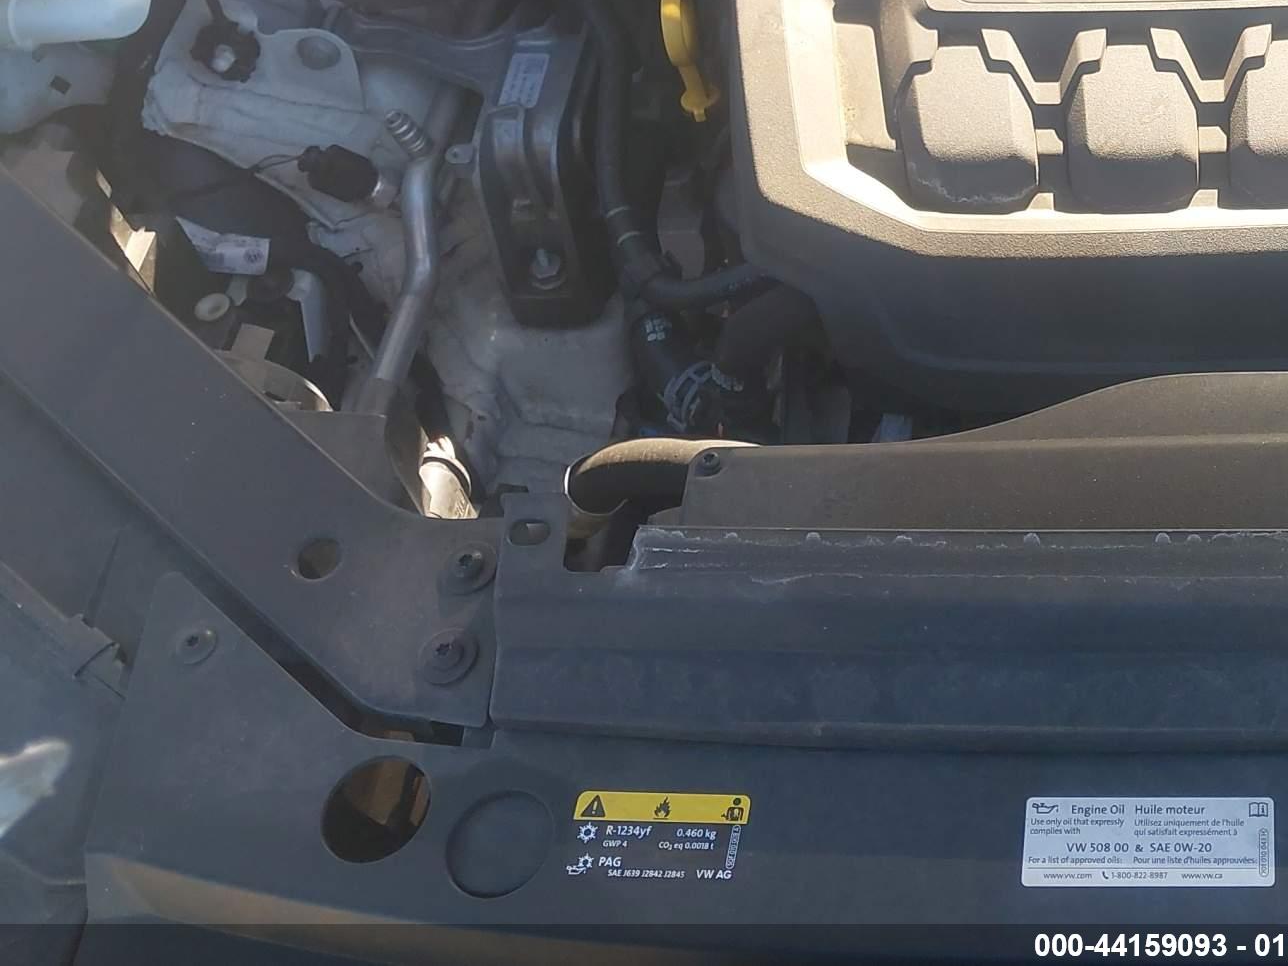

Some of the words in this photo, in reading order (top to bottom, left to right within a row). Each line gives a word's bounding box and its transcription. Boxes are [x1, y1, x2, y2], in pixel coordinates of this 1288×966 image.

[1071, 804, 1107, 817] Engine
[1110, 804, 1125, 814] Oil
[1135, 804, 1163, 815] Huile
[1165, 805, 1206, 815] moteur
[1030, 818, 1045, 826] Use
[1046, 818, 1062, 827] only
[1063, 818, 1072, 826] oil
[1073, 818, 1089, 826] that
[1090, 818, 1124, 828] expressly
[1134, 819, 1161, 827] Utilisez
[1163, 819, 1209, 829] uniquement
[1211, 819, 1220, 827] de
[1221, 818, 1245, 827] l'huile
[606, 825, 653, 839] R-1234yf
[676, 828, 704, 838] 0.460
[705, 829, 717, 840] kg
[1030, 827, 1062, 836] complies
[1064, 827, 1081, 835] with
[1133, 829, 1146, 838] qui
[1147, 828, 1177, 836] satisfait
[1178, 828, 1232, 838] expressément
[674, 842, 684, 851] eq
[684, 841, 709, 850] 0.0018
[1066, 842, 1087, 853] VW
[1090, 842, 1111, 853] 508
[1113, 842, 1130, 853] 00
[1134, 844, 1144, 853] &
[1150, 842, 1171, 852] SAE
[1173, 842, 1212, 852] 0W-20
[598, 856, 622, 867] PAG
[1028, 856, 1040, 864] For
[1048, 856, 1059, 864] list
[1060, 856, 1069, 864] of
[1070, 856, 1106, 866] approved
[1133, 856, 1150, 864] Pour
[1167, 856, 1182, 864] liste
[1183, 856, 1211, 864] d'huiles
[607, 869, 622, 877] SAE
[623, 869, 641, 878] J639
[641, 869, 663, 878] J2842
[664, 870, 686, 878] J2845
[696, 869, 715, 879] VW
[715, 870, 733, 880] AG
[1043, 872, 1092, 880] www.vw.com
[1111, 871, 1168, 879] 1-800-822-8987
